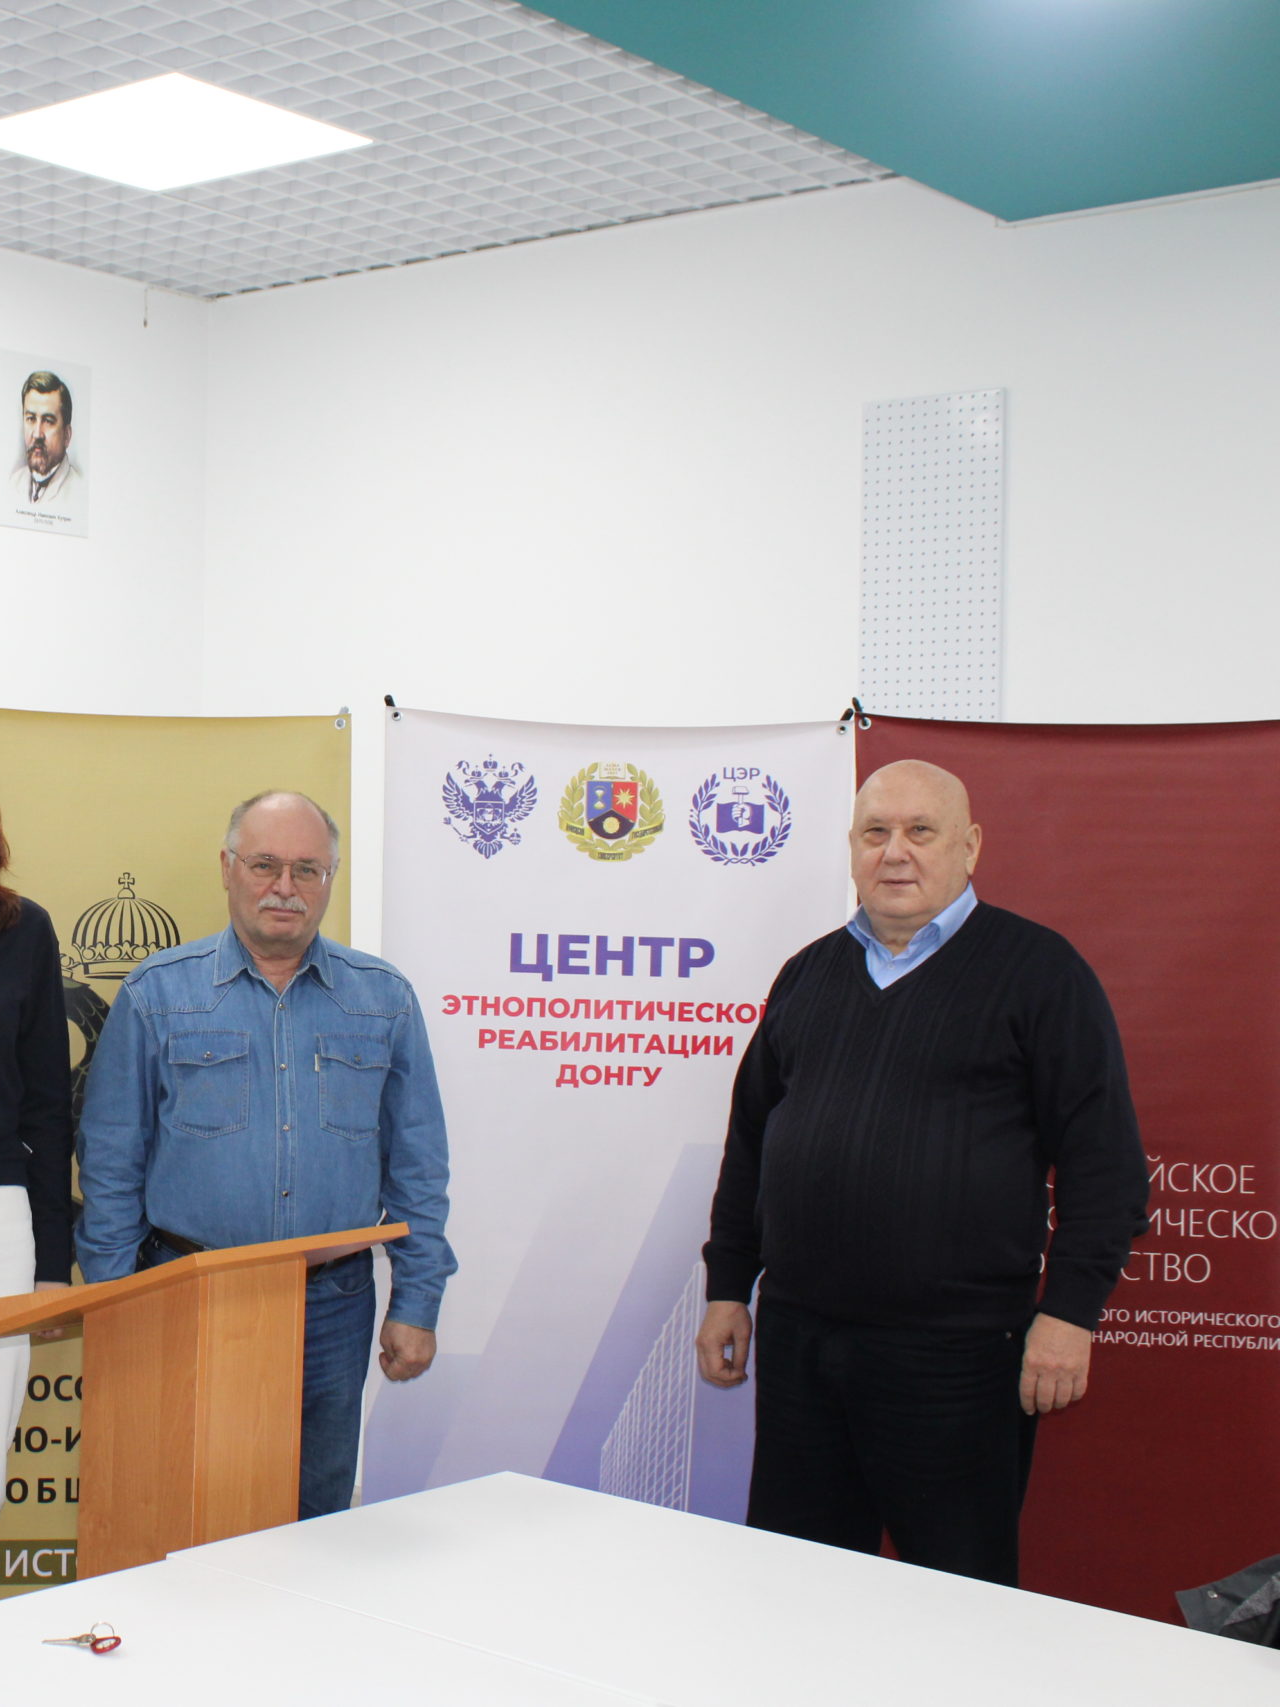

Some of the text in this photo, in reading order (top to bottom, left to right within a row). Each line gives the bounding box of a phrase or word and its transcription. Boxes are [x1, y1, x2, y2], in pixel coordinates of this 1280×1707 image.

[723, 767, 761, 782] ЦЭР
[509, 933, 716, 982] ЦЕНТР
[478, 1028, 734, 1059] РЕАБИЛИТАЦИИ
[555, 1064, 663, 1089] ДОНГУ
[1135, 1309, 1280, 1329] ИСТОРИЧЕСКОГО
[1092, 1330, 1189, 1348] НАРОДНОЙ
[5, 1548, 78, 1577] ИСТ
